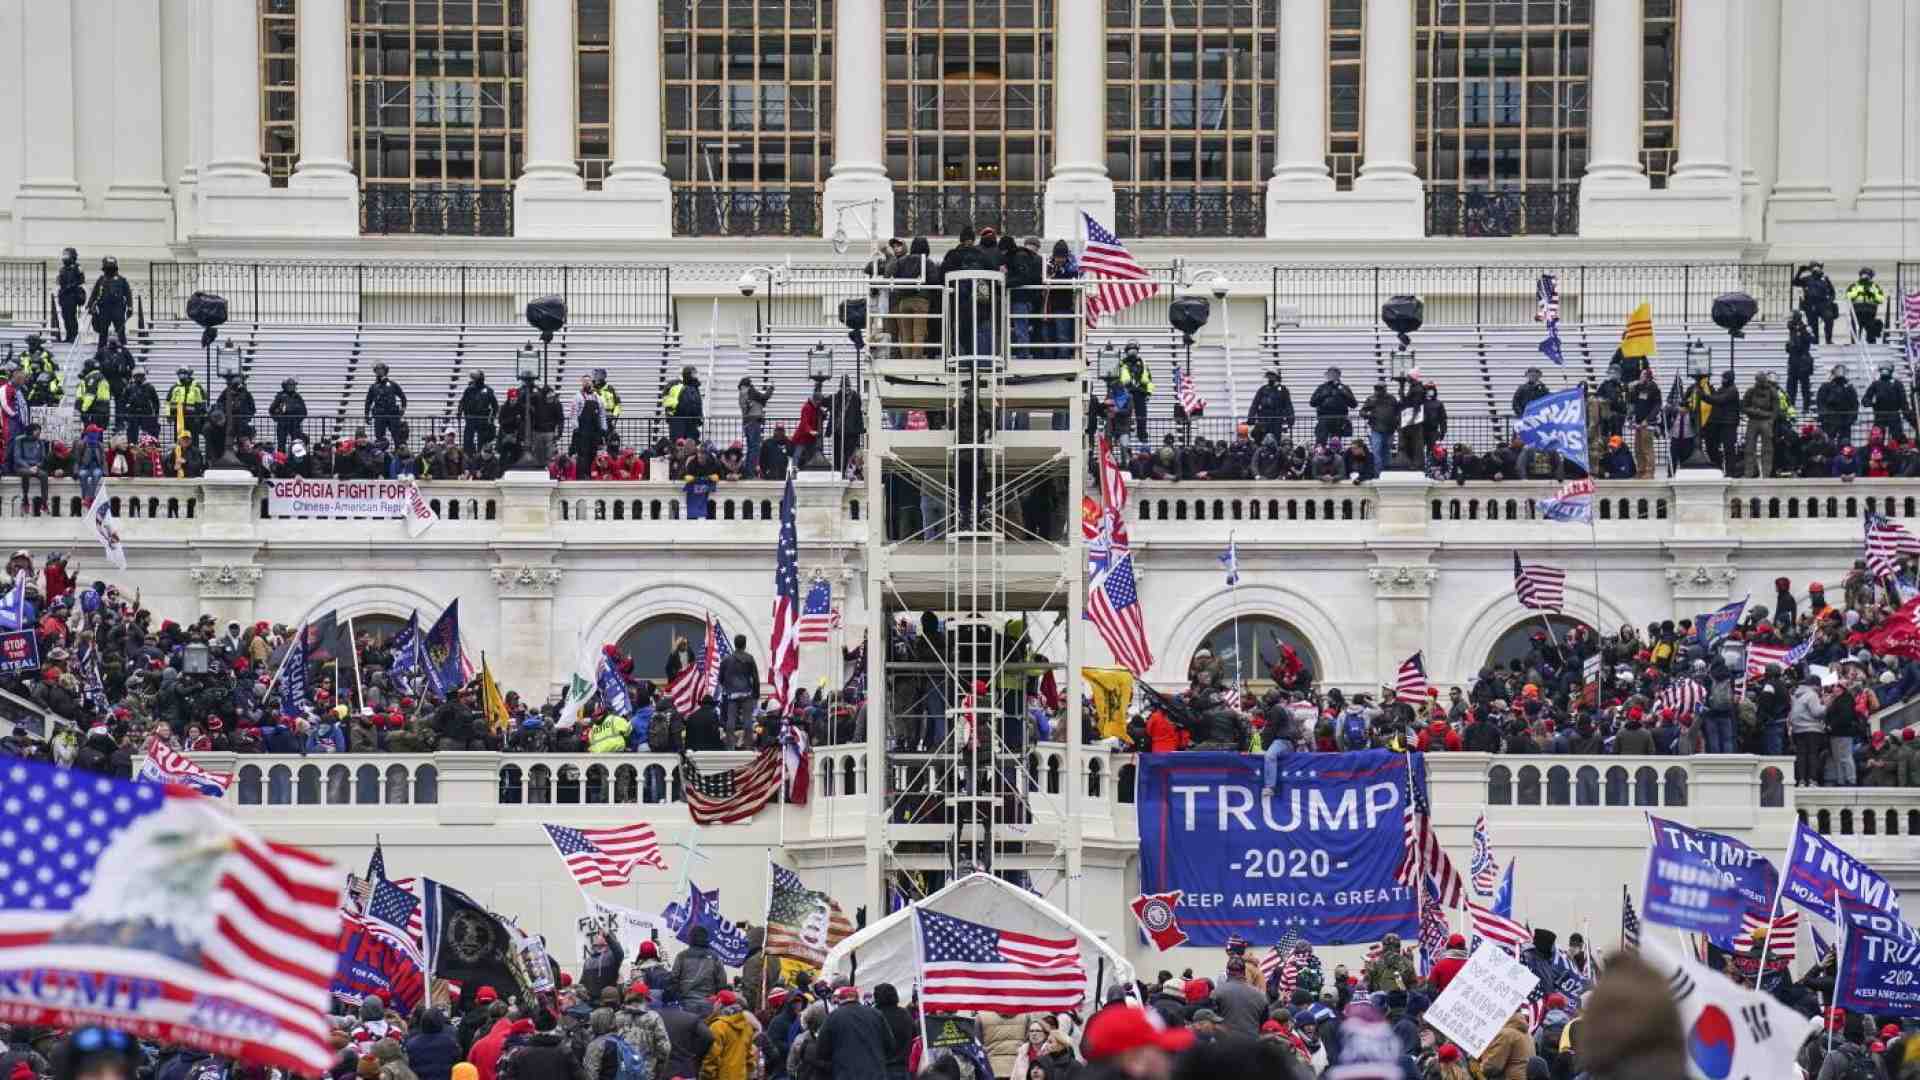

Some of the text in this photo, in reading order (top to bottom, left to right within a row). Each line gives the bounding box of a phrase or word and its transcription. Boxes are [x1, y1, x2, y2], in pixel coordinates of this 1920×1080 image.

[275, 482, 333, 498] GEORGIA
[338, 483, 375, 499] FIGHT
[379, 484, 406, 499] FOR
[292, 501, 378, 512] Chinese-American
[4, 639, 26, 651] STOP
[0, 658, 37, 671] STEAL
[1171, 781, 1400, 832] TRUMP
[1232, 893, 1325, 908] AMERICA
[1335, 886, 1411, 906] GREAT!
